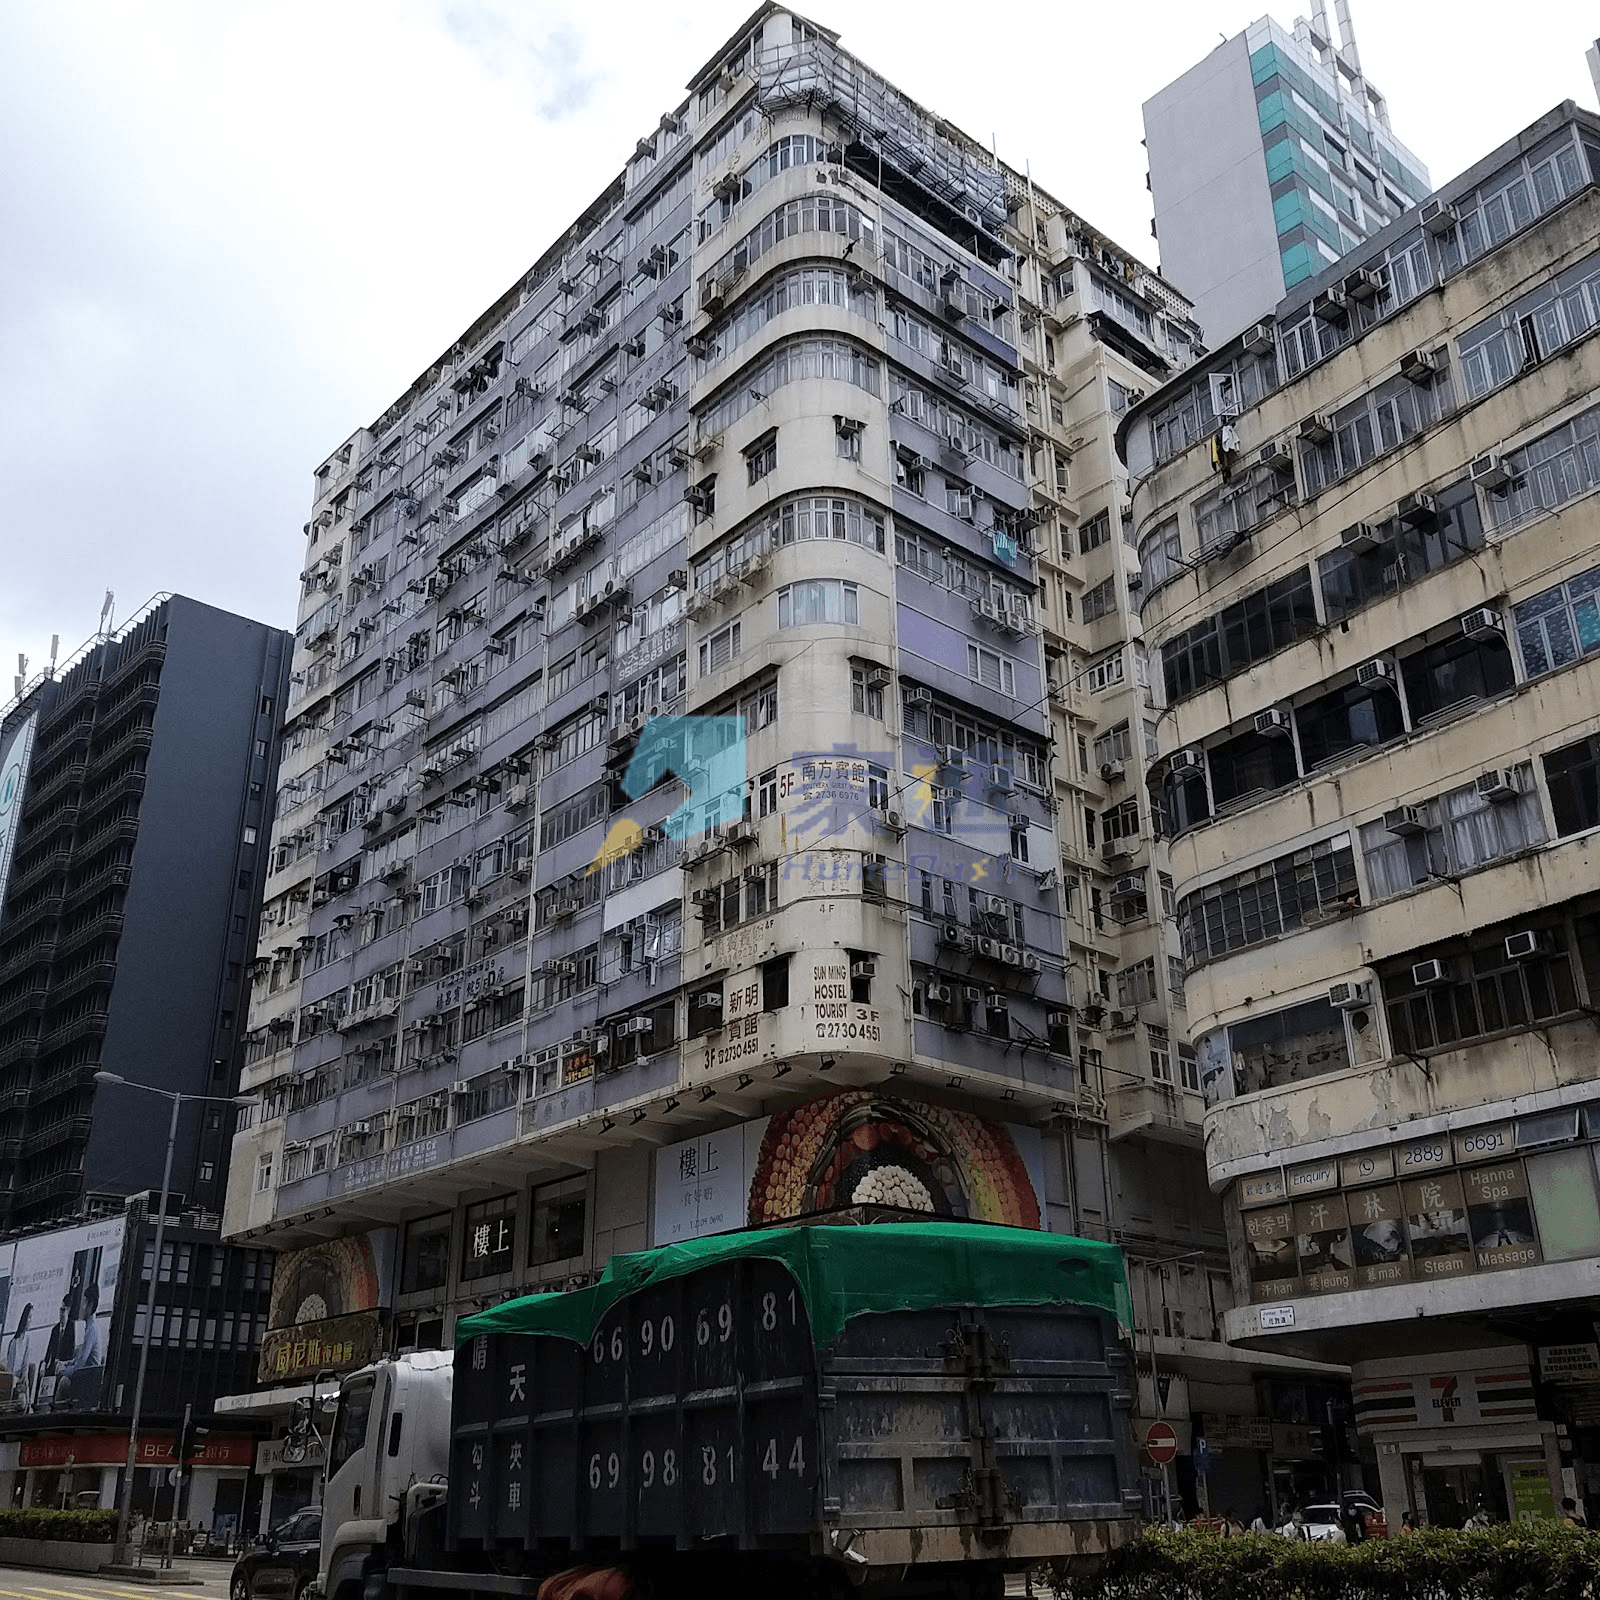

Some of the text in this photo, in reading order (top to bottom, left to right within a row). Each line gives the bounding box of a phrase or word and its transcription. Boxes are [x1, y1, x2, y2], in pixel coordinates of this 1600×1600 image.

[780, 760, 865, 799] 5F 南方賓館
[802, 783, 829, 791] SOUTHERN
[850, 784, 865, 793] HOUSE
[816, 791, 859, 800] 2736 6976
[814, 965, 846, 981] SUN MING
[729, 983, 758, 1014] 新明
[814, 984, 847, 999] HOSTEL
[814, 1003, 847, 1018] TOURIST
[729, 1014, 758, 1042] 賓館
[704, 1048, 716, 1069] 3F
[1405, 1132, 1505, 1165] 2889 6691
[679, 1141, 719, 1181] 樓上
[1293, 1170, 1330, 1186] Enquiry
[1471, 1169, 1515, 1186] Hanna
[1481, 1186, 1509, 1200] Spa
[1247, 1212, 1290, 1237] 한증막
[473, 1220, 509, 1258] 樓上
[1424, 1259, 1463, 1273] Steam
[1478, 1249, 1535, 1267] Massage
[1378, 1266, 1401, 1279] mak
[1274, 1283, 1293, 1296] han
